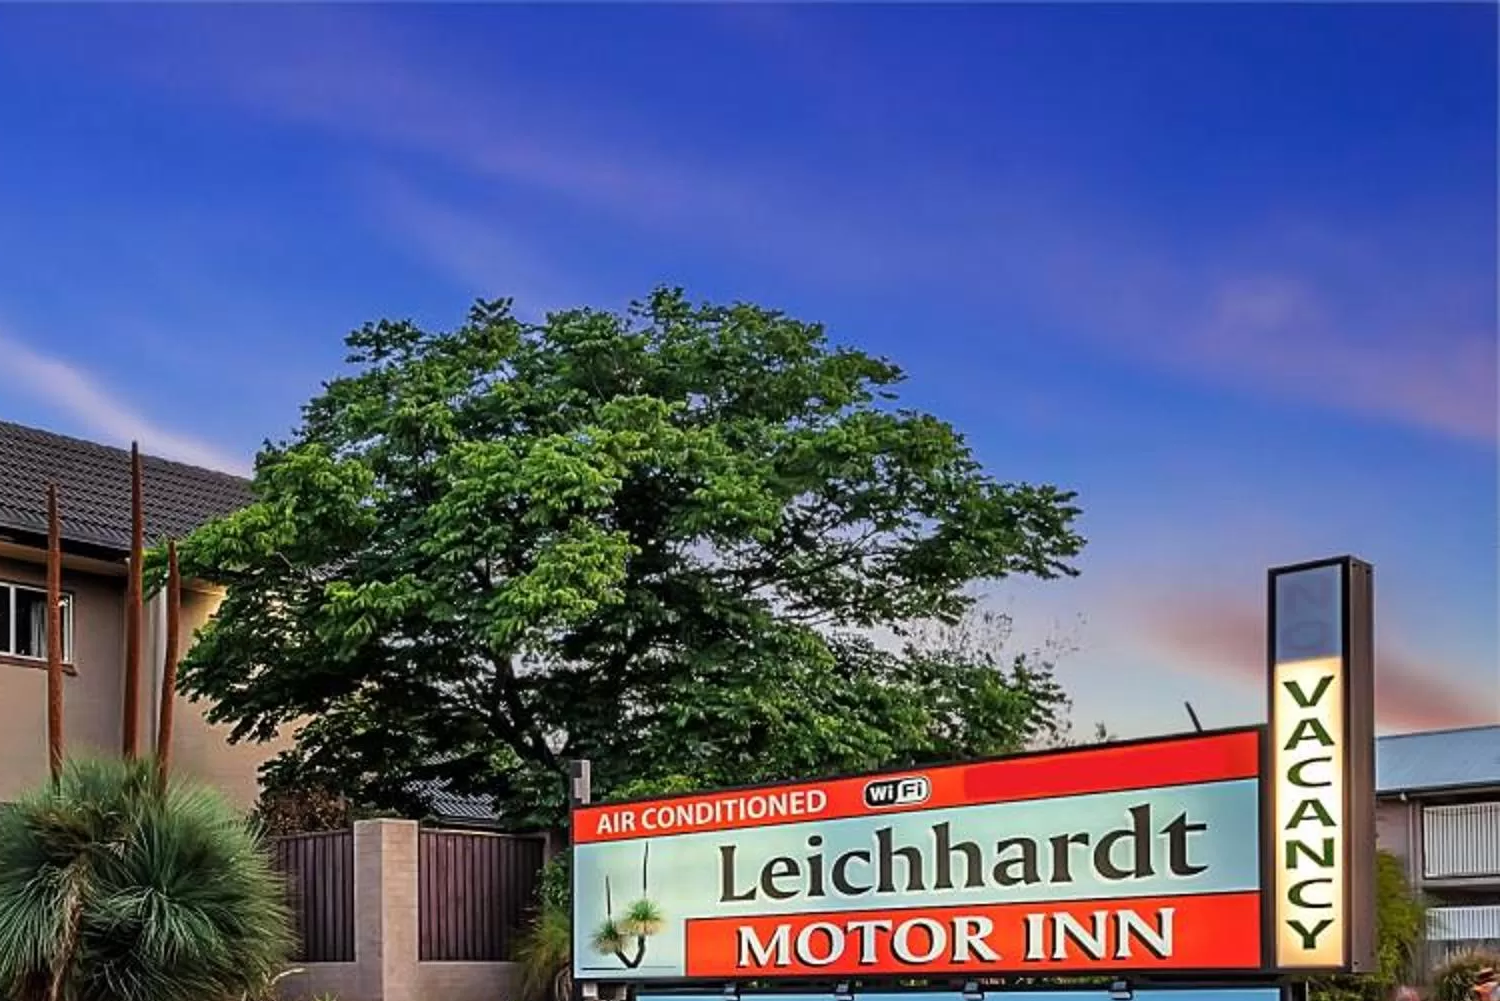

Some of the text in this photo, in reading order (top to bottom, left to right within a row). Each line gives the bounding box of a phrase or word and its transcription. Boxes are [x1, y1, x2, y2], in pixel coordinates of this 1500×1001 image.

[597, 810, 635, 835] AIR
[641, 789, 827, 830] CONDITIONED
[1283, 676, 1336, 950] VACANCY
[719, 804, 1209, 903] Leichhardt
[737, 906, 1176, 968] MOTOR INN
